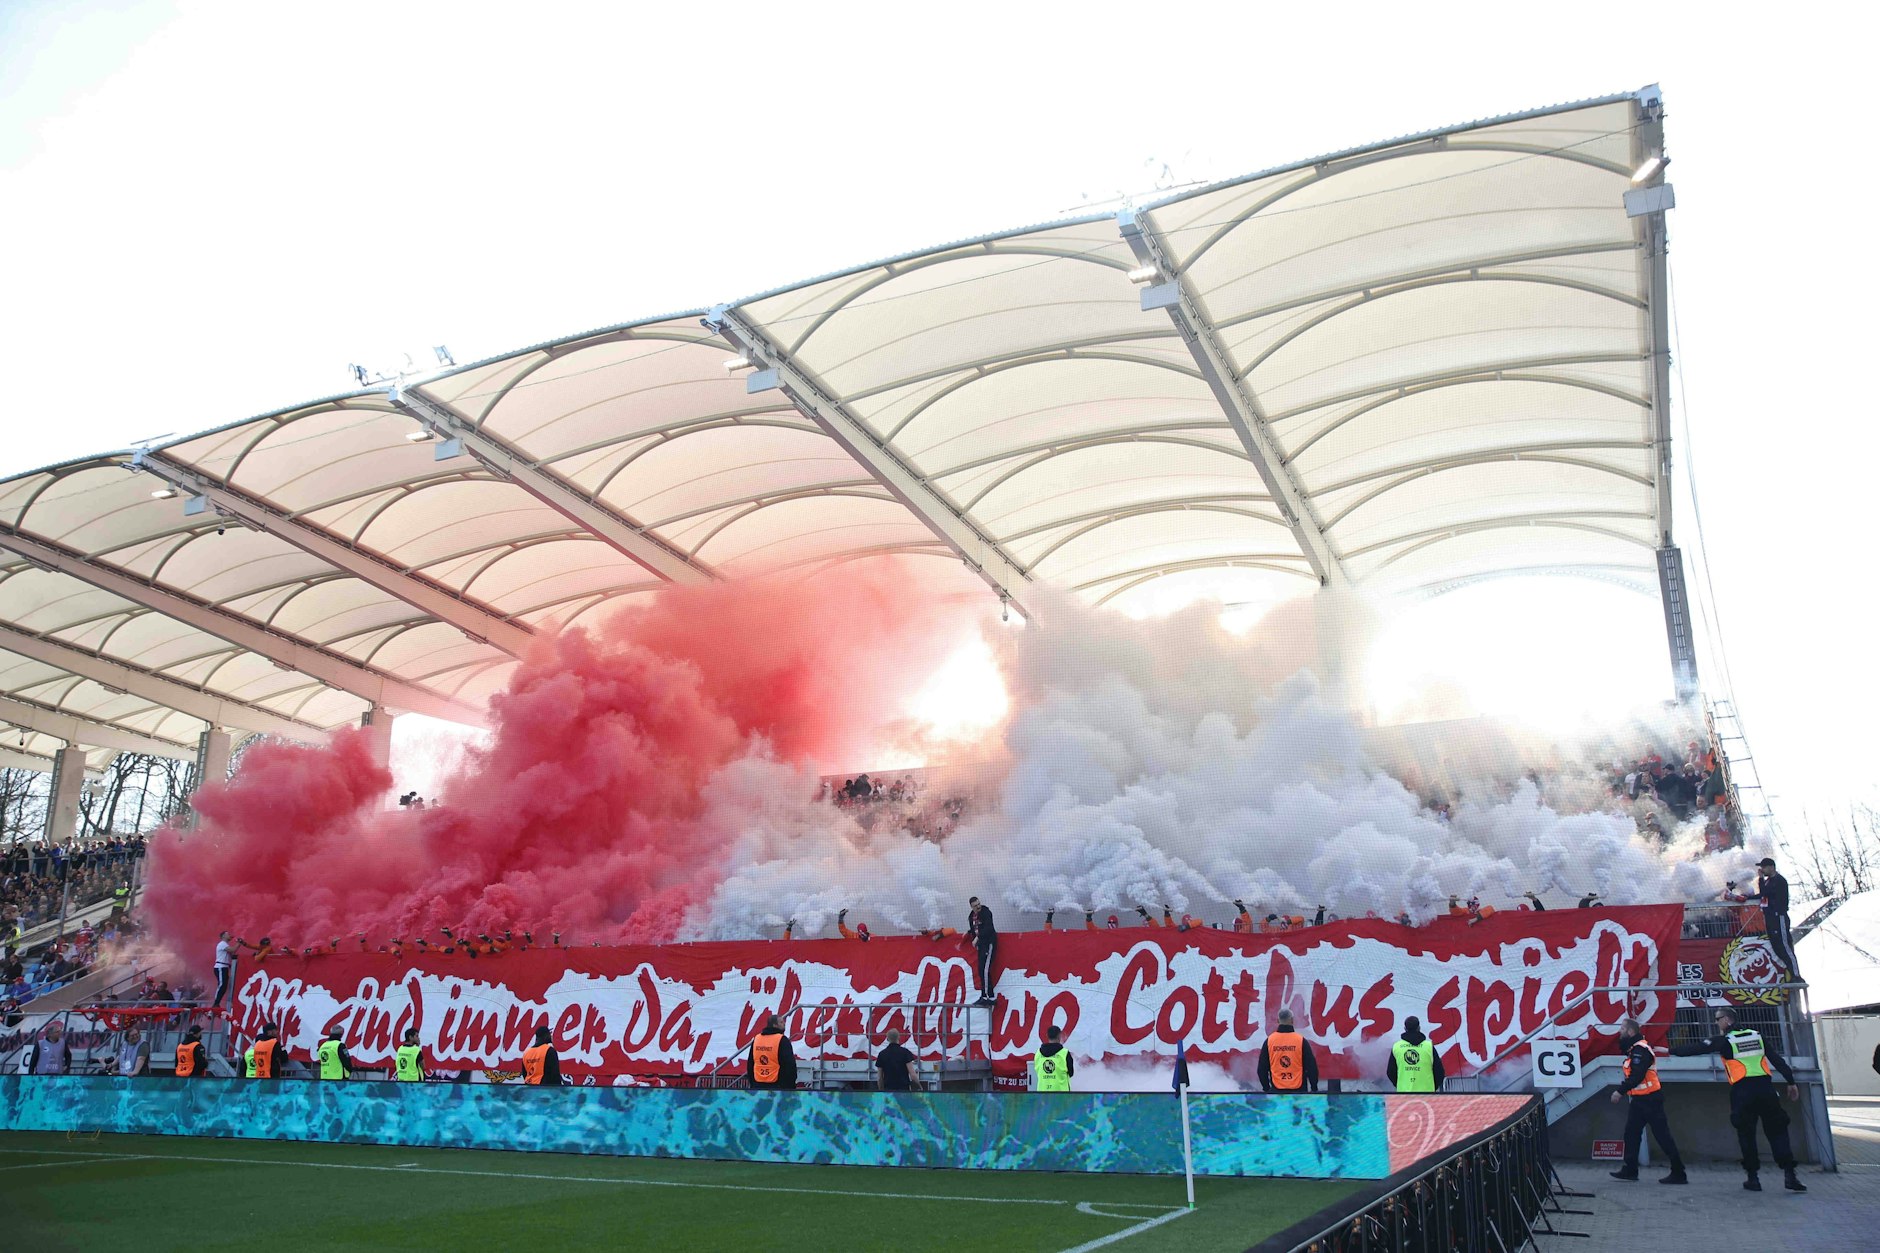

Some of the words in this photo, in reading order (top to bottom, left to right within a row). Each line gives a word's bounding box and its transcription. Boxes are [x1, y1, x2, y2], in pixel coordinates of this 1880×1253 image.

[318, 976, 423, 1052] sind
[438, 983, 607, 1056] immer
[736, 962, 966, 1051] überall
[991, 990, 1080, 1053] wo
[1110, 948, 1394, 1044] Cottbus
[1428, 928, 1650, 1062] spielt
[1538, 1051, 1576, 1076] C3
